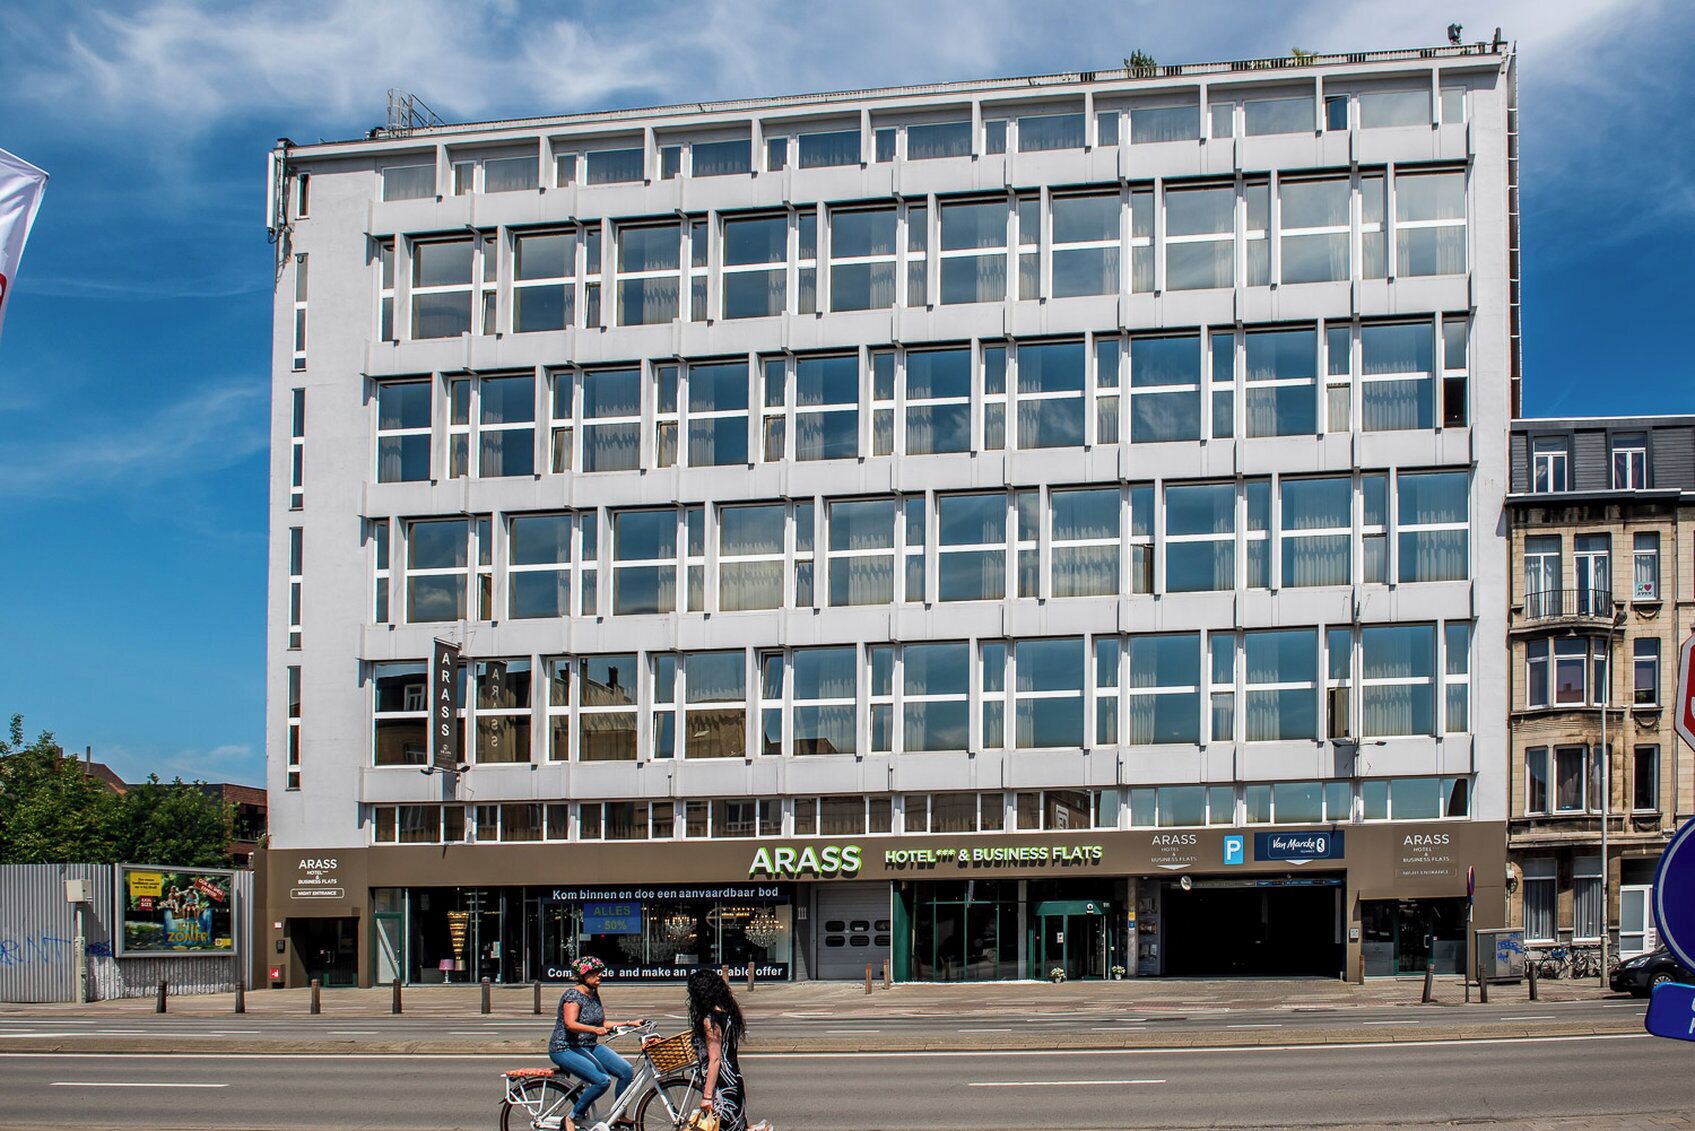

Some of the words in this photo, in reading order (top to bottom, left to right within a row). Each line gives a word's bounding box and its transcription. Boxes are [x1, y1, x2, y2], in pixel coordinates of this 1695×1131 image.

[441, 652, 450, 737] ARASS
[1152, 834, 1197, 845] ARASS
[1273, 837, 1286, 850] Van
[1287, 838, 1315, 850] Marcke
[1403, 834, 1449, 845] ARASS
[958, 848, 970, 861] &
[973, 846, 1049, 861] BUSINESS
[1052, 845, 1104, 860] FLATS
[1227, 840, 1241, 860] P
[298, 859, 337, 869] ARASS
[749, 845, 863, 874] ARASS
[553, 890, 577, 900] Kom
[580, 890, 617, 899] binnen
[619, 891, 632, 899] en
[635, 889, 654, 898] doe
[657, 890, 677, 898] een
[679, 888, 755, 898] aanvaardbaar
[759, 887, 778, 896] bod
[593, 906, 631, 916] ALLES
[548, 968, 572, 977] Com
[619, 967, 639, 977] and
[642, 967, 671, 977] make
[673, 969, 687, 977] an
[756, 967, 783, 976] offer
